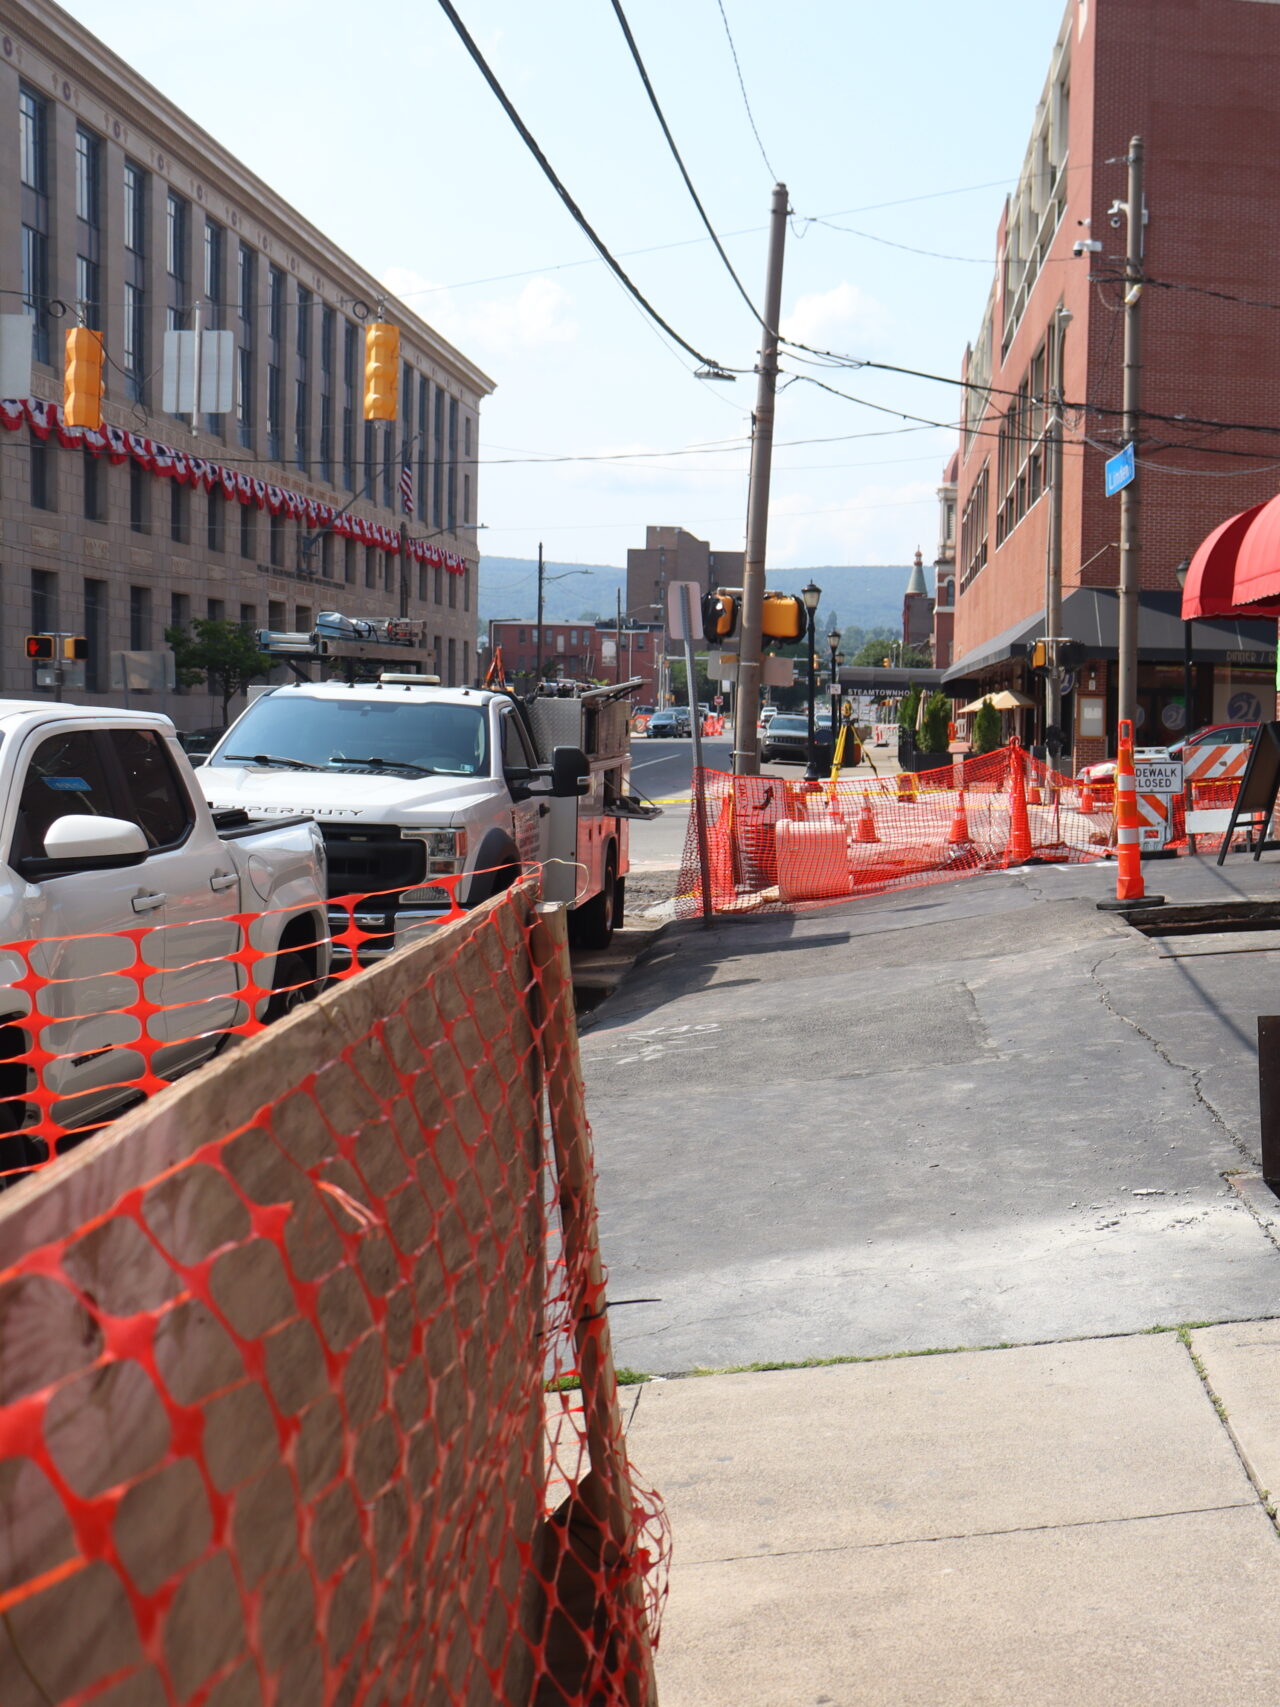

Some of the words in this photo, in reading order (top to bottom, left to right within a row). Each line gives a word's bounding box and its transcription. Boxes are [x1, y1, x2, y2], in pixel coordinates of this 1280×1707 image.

[1135, 768, 1177, 778] DEWALK
[1135, 778, 1172, 788] LOSED
[301, 808, 364, 816] DUTY
